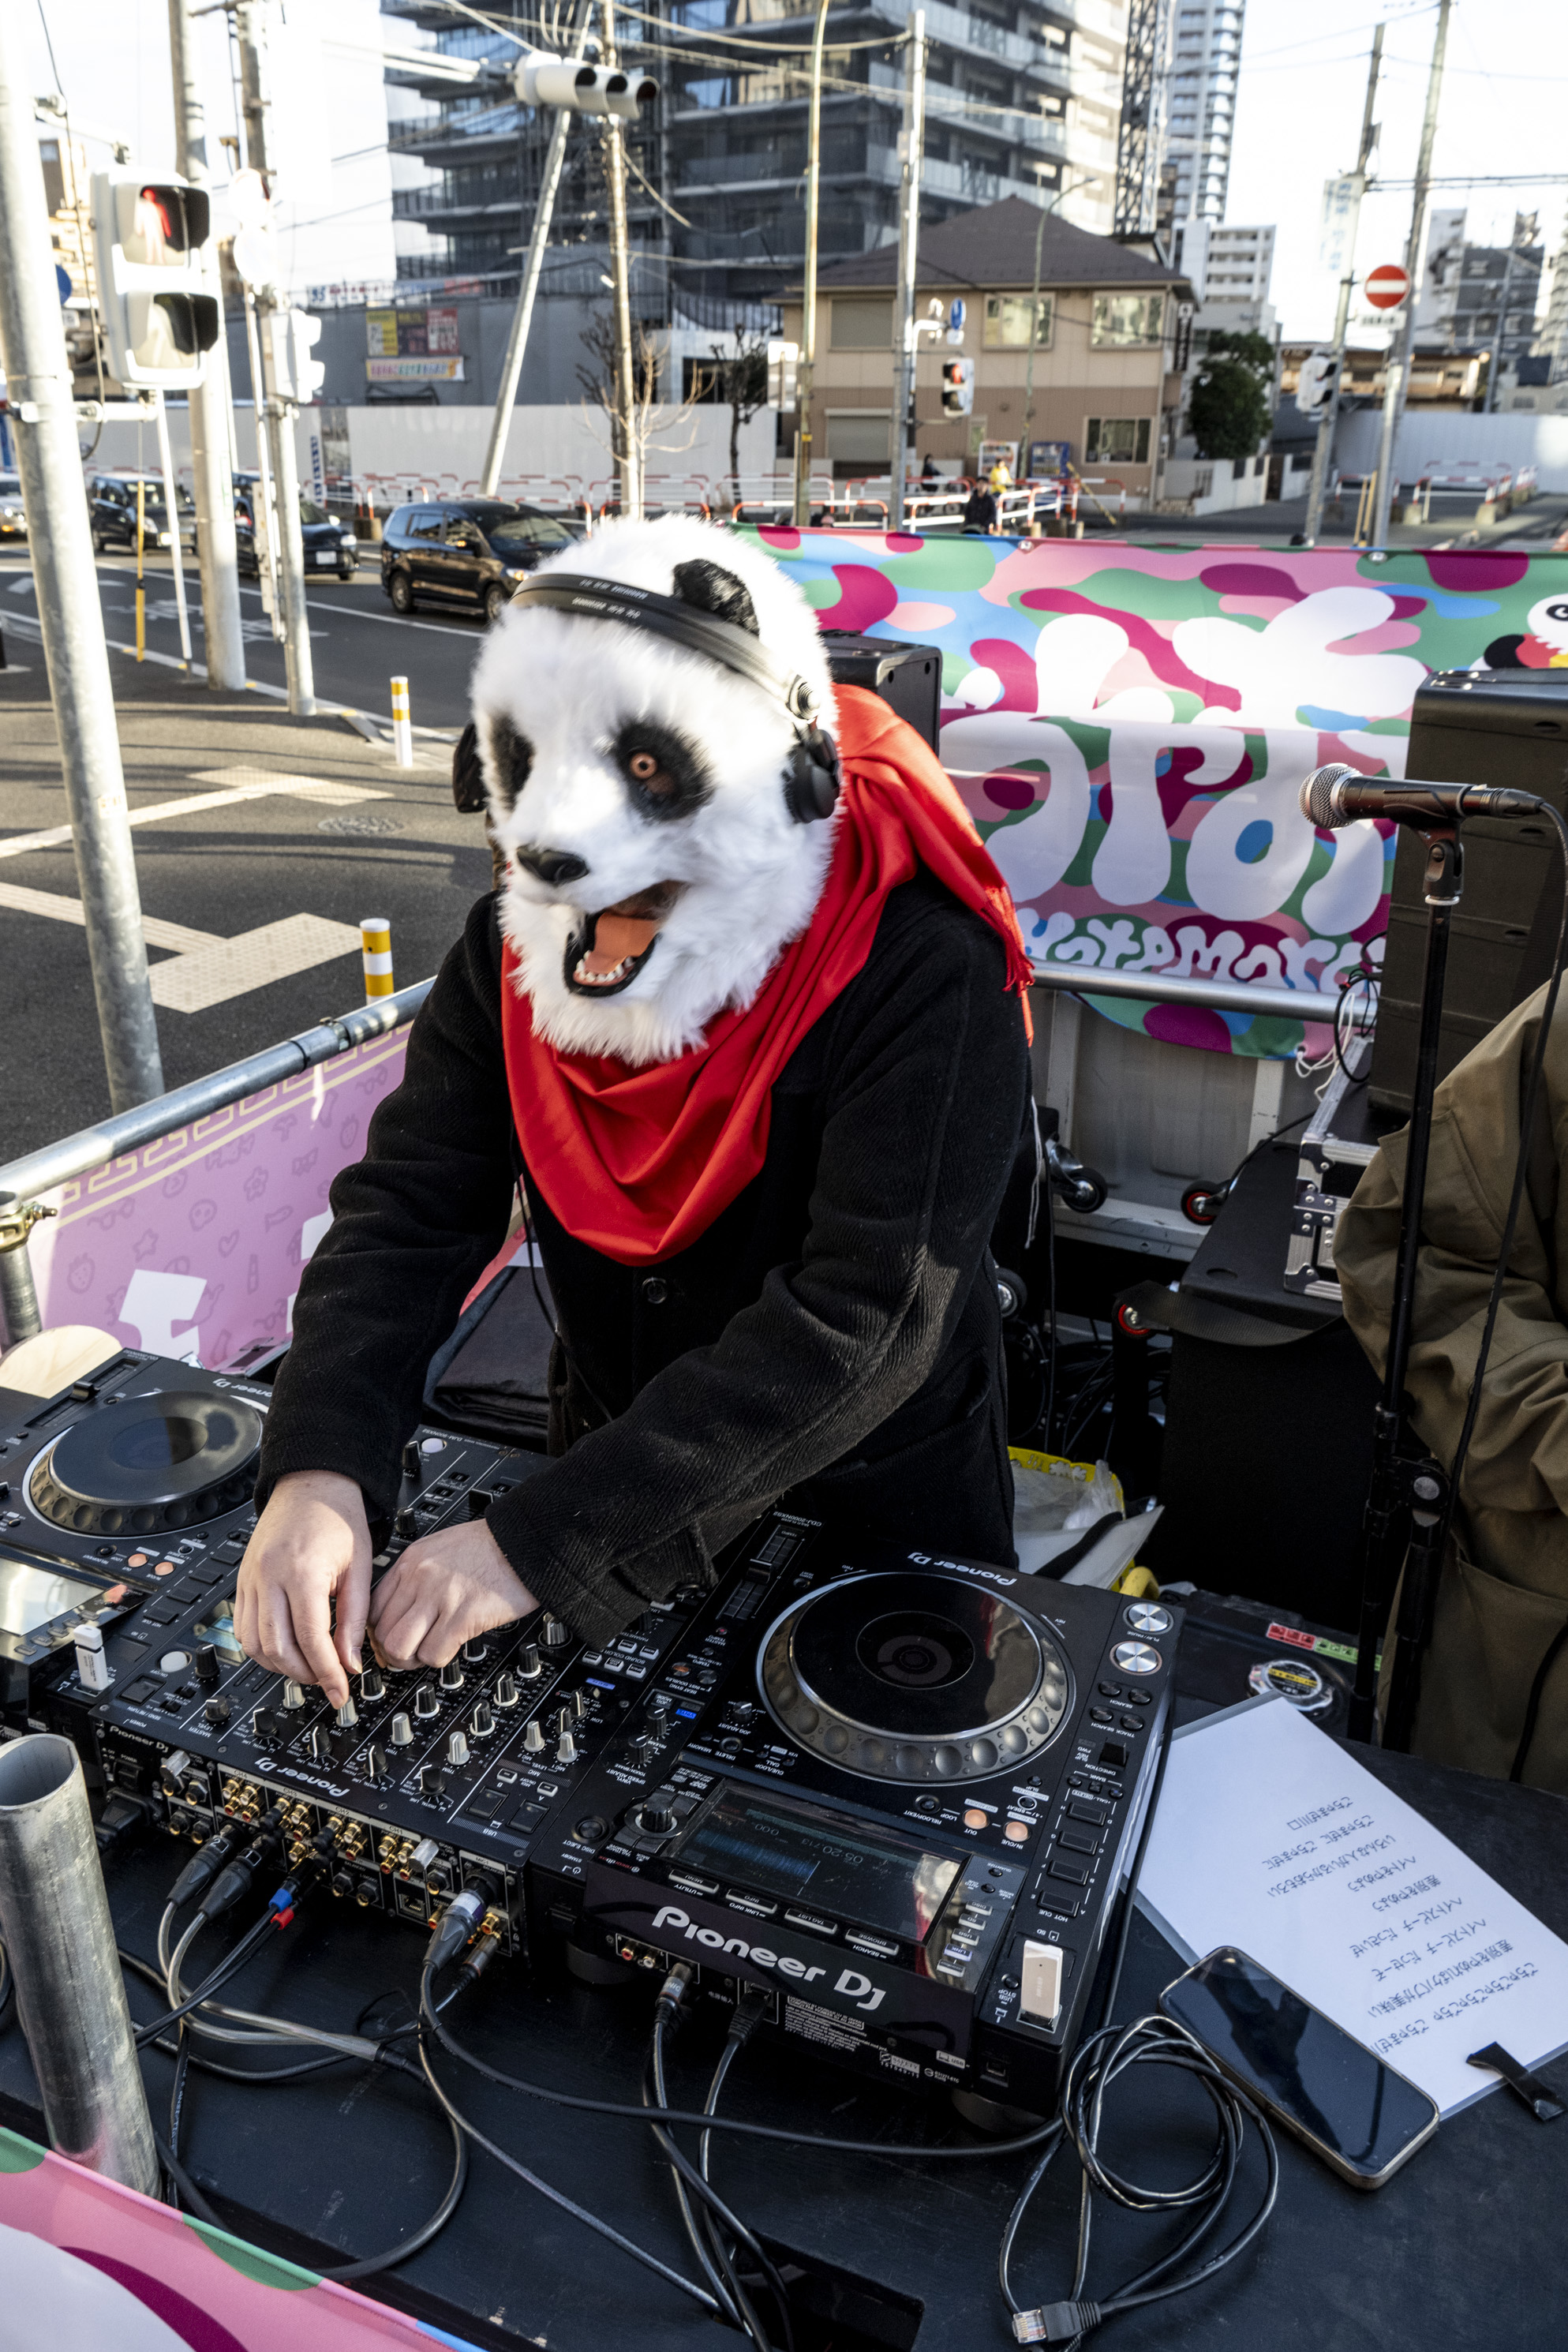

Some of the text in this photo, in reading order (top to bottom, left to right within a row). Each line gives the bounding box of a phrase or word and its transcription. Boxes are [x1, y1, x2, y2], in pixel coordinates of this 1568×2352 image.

[907, 1552, 1017, 1586] Pioneer DJ
[150, 1668, 168, 1678] ON/OFF
[665, 1676, 687, 1686] DOUBLES
[1110, 1699, 1132, 1709] SEARCH
[129, 1718, 147, 1728] POWER
[197, 1722, 214, 1732] LEVEL
[717, 1721, 739, 1732] ADJUST
[188, 1726, 211, 1738] MASTER
[1091, 1722, 1135, 1738] TRACK SEARCH
[109, 1725, 169, 1753] Pioneer DJ
[301, 1730, 311, 1743] 3
[687, 1742, 713, 1754] MEMORY
[356, 1749, 368, 1762] 2
[714, 1750, 735, 1761] DELETE
[532, 1762, 548, 1770] LEVEL
[754, 1763, 784, 1776] CUE/LOOP
[765, 1759, 780, 1768] CALL
[1085, 1763, 1116, 1776] DIRECTION
[614, 1763, 646, 1777] TOUCH/BRAKE
[254, 1757, 350, 1798] Pioneer DJ
[606, 1769, 646, 1785] SPEED ADJUST
[1090, 1773, 1106, 1783] BANK
[421, 1801, 436, 1810] DIGITAL
[904, 1809, 942, 1826] RELOOP/EXIT
[941, 1812, 957, 1822] LOOP
[1286, 1796, 1353, 1831] ごちゃまぜ川口
[389, 1825, 403, 1834] CH1
[483, 1827, 497, 1837] USB
[210, 1837, 221, 1847] 2
[563, 1840, 581, 1849] EJECT
[1001, 1839, 1024, 1849] IN/CUE
[1261, 1815, 1375, 1870] ごちゃまぜに ごちゃまぜに
[561, 1853, 582, 1863] STANDBY
[1267, 1834, 1395, 1897] いろんな人がいるからおもろい
[685, 1874, 703, 1884] MENU
[1347, 1856, 1416, 1892] ヘイトをやめよう
[674, 1883, 698, 1895] UTILITY
[1371, 1874, 1441, 1912] 差別をやめよう
[744, 1895, 759, 1904] INFO
[729, 1902, 759, 1916] LINK INFO
[1038, 1908, 1052, 1917] CUE
[798, 1912, 813, 1921] LIST
[1349, 1897, 1462, 1958] ヘイトスピーチ だっさいぜ
[859, 1933, 887, 1946] BROWSE
[1425, 1919, 1487, 1955] ヘイトスピーチ
[852, 1945, 880, 1957] SEARCH
[651, 1905, 888, 2011] Pioneer DJ
[1368, 1939, 1514, 2018] 差別をやめればケバブが美味い
[997, 1989, 1016, 1998] STOP
[1432, 1962, 1539, 2021] ごちゃごちゃごちゃごちゃ
[998, 1994, 1012, 2003] USB
